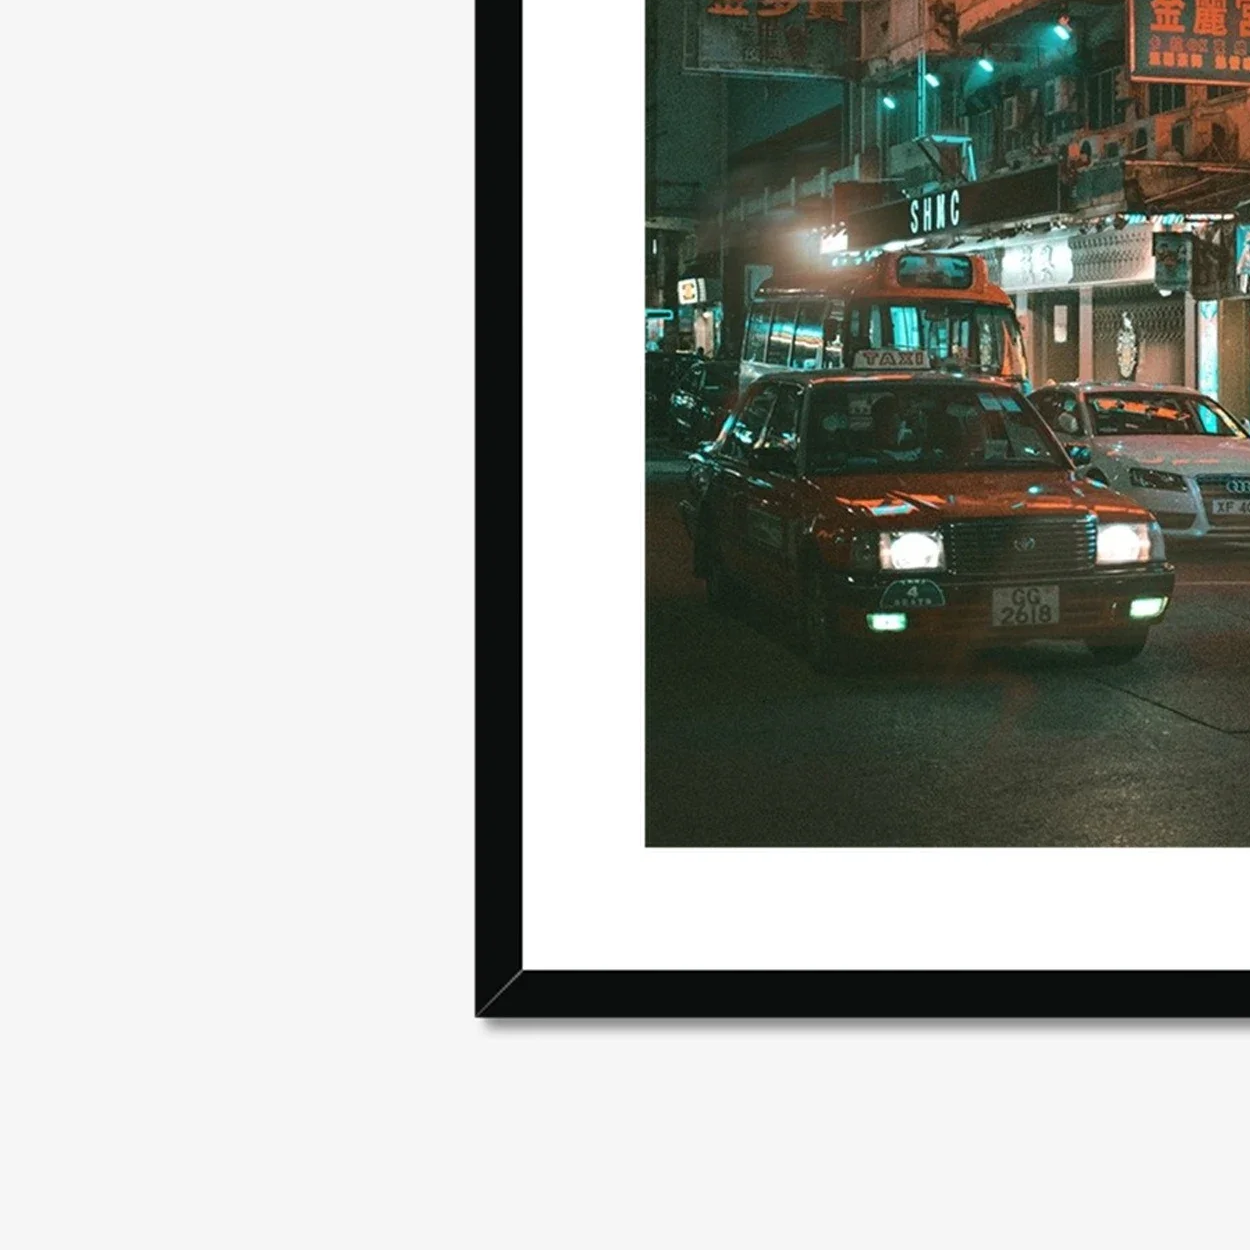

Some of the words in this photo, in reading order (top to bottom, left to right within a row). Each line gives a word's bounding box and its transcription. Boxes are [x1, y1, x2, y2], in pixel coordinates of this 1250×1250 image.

[863, 350, 924, 366] TAXI
[1217, 501, 1233, 513] XF
[1012, 588, 1041, 607] GG
[1000, 604, 1052, 625] 2618
